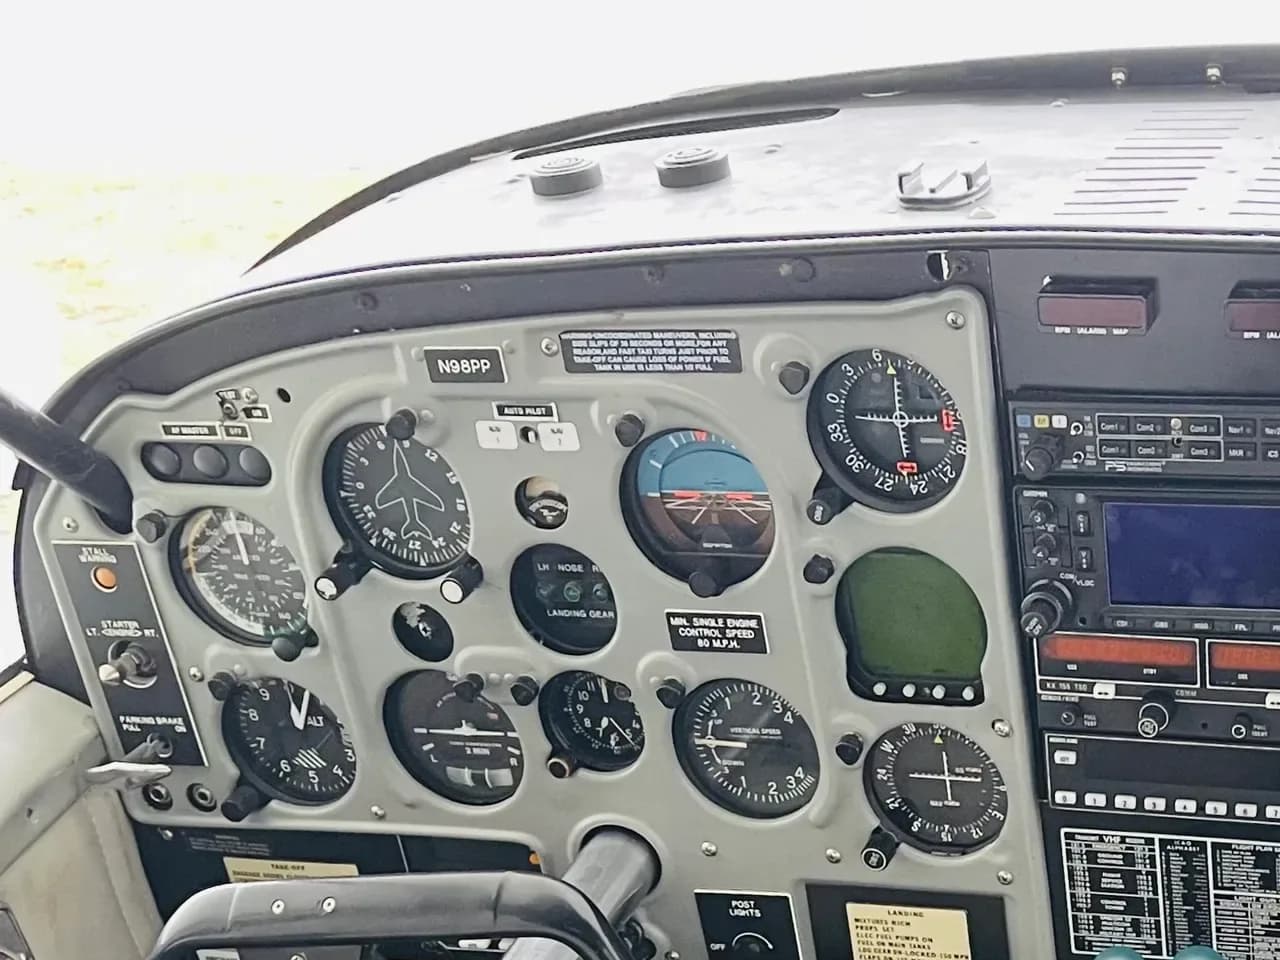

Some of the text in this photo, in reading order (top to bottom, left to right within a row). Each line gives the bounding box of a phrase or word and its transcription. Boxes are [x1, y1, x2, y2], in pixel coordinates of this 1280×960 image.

[1113, 327, 1128, 335] MAP
[872, 349, 882, 362] 6
[437, 358, 491, 374] N98PP
[842, 363, 854, 377] 3
[826, 393, 840, 404] 0
[504, 407, 546, 415] AUTO PILOT
[827, 423, 843, 442] 33
[956, 439, 967, 455] 18
[1268, 450, 1279, 458] ICS
[845, 454, 864, 473] 30
[939, 466, 956, 484] 21
[874, 477, 894, 492] 27
[910, 480, 928, 495] 24
[537, 563, 584, 572] LH NOSE
[546, 609, 616, 619] LANDING GEAR
[101, 620, 140, 629] STARTER
[670, 617, 759, 629] MIN. SINGLE ENGINE
[678, 628, 755, 639] CONTROL SPEED
[259, 688, 270, 701] 9
[752, 692, 762, 705] 2
[1175, 689, 1197, 697] COMM
[725, 697, 731, 710] 1
[772, 700, 783, 713] 3
[119, 715, 184, 726] PARKING BRAKE
[248, 709, 259, 721] 8
[784, 711, 794, 724] 4
[307, 716, 324, 727] ALT
[730, 727, 760, 735] VERTICAL
[255, 737, 265, 749] 7
[344, 749, 355, 762] 3
[280, 760, 291, 772] 6
[332, 765, 343, 776] 4
[308, 771, 319, 783] 5
[794, 766, 805, 780] 4
[741, 776, 747, 788] 1
[786, 776, 796, 789] 3
[768, 782, 778, 795] 2
[731, 900, 754, 909] POST
[729, 908, 761, 918] LIGHTS
[710, 943, 726, 951] OFF
